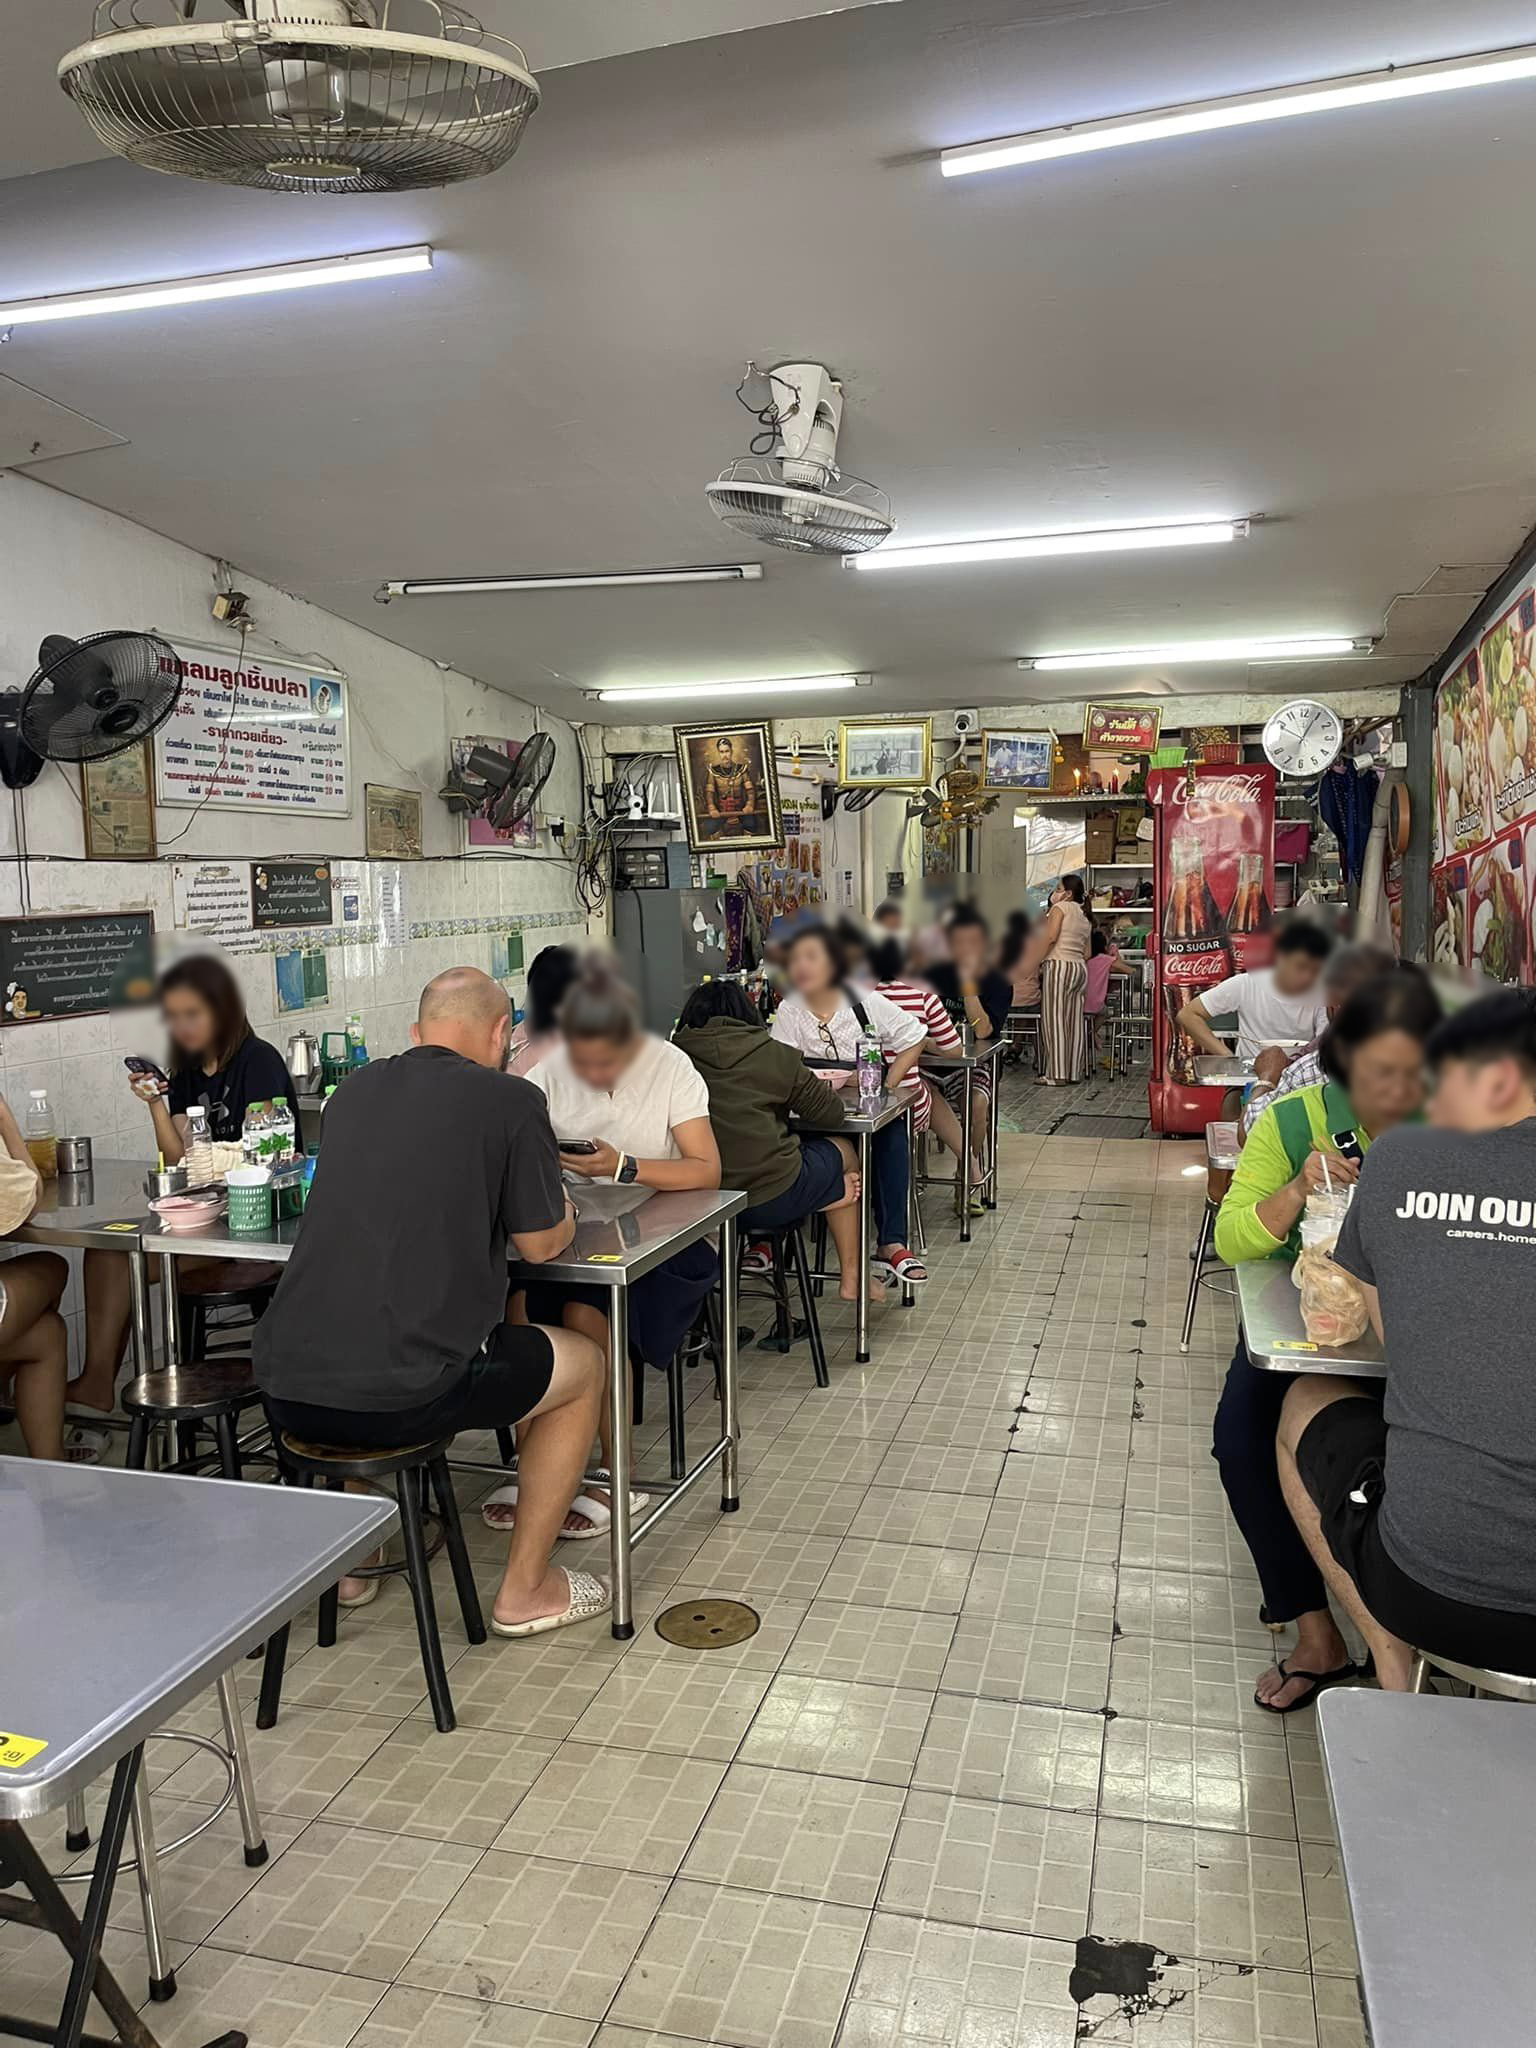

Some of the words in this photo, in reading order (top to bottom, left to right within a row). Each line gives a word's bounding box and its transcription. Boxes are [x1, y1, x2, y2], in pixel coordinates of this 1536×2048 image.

[1300, 708, 1309, 718] 12
[1321, 721, 1331, 730] 2
[1284, 755, 1292, 764] 7
[1298, 759, 1304, 768] 6
[1310, 756, 1318, 765] 5
[1169, 944, 1184, 953] NO
[1186, 940, 1220, 952] SUGAR
[1165, 955, 1224, 976] Coca-Cola
[1396, 1191, 1475, 1222] JOIN
[1480, 1197, 1536, 1229] OU
